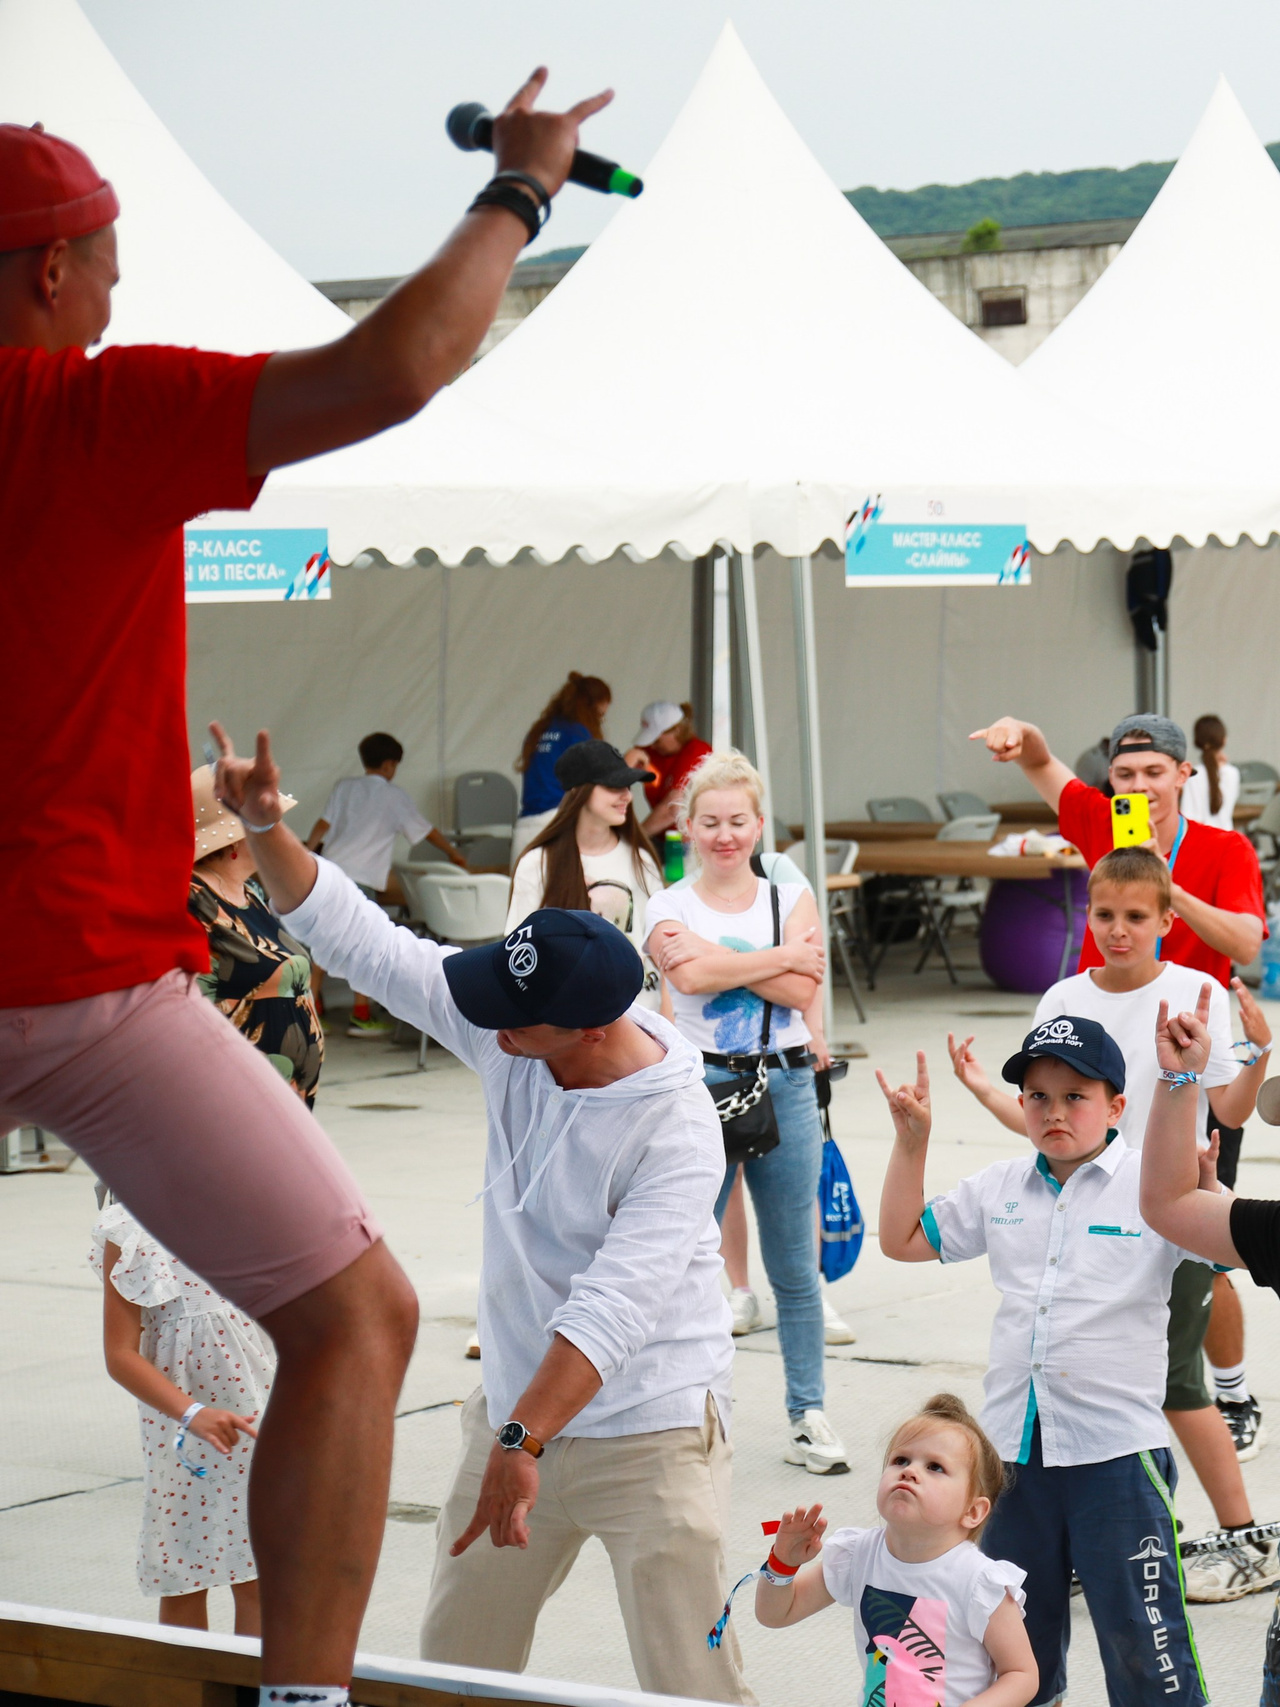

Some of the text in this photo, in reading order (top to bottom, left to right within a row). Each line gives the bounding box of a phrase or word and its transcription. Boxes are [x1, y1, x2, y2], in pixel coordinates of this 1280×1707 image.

[892, 531, 983, 548] МАСТЕР-КЛАСС
[198, 563, 218, 581] ИЗ
[224, 562, 286, 581] ПЕСКА»
[505, 924, 538, 977] 50
[1034, 1020, 1074, 1041] 50
[1065, 1039, 1083, 1048] ПОРТ
[1143, 1561, 1181, 1694] DASWAN
